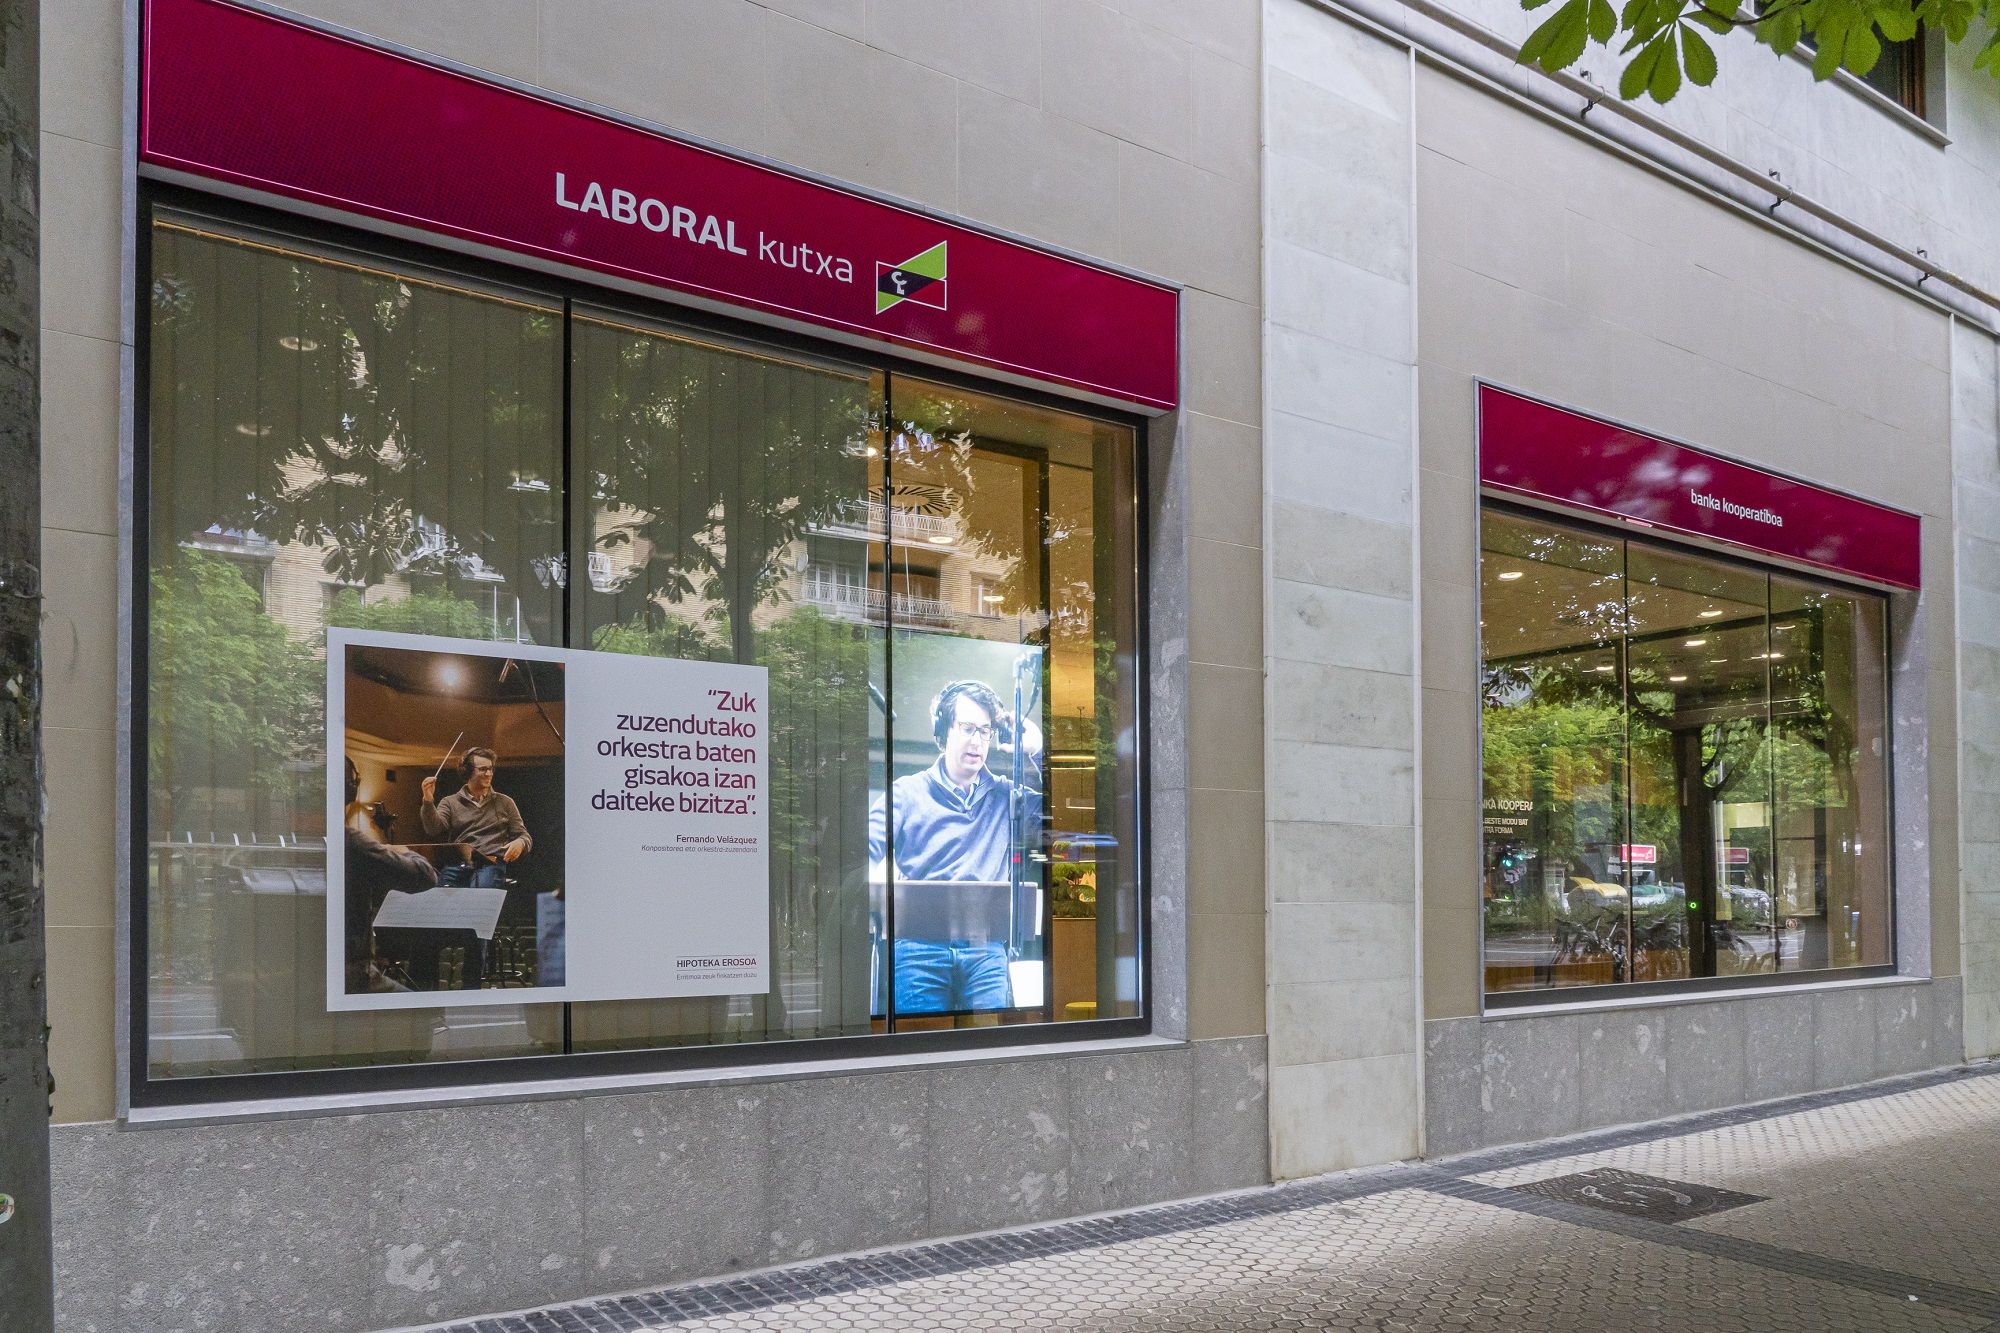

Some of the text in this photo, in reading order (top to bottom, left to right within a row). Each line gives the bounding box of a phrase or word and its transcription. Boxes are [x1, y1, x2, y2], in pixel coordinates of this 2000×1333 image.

[556, 172, 853, 284] LABORAL kutxa
[1690, 488, 1783, 527] banka kooperatiboa
[616, 714, 756, 738] zuzendutako
[597, 736, 756, 763] orkestra baten
[624, 764, 756, 789] gisakoa izan
[591, 789, 675, 811] daiteke
[676, 834, 757, 845] Fernando Velázquez
[676, 957, 757, 968] HIPOTEKA EROSOA
